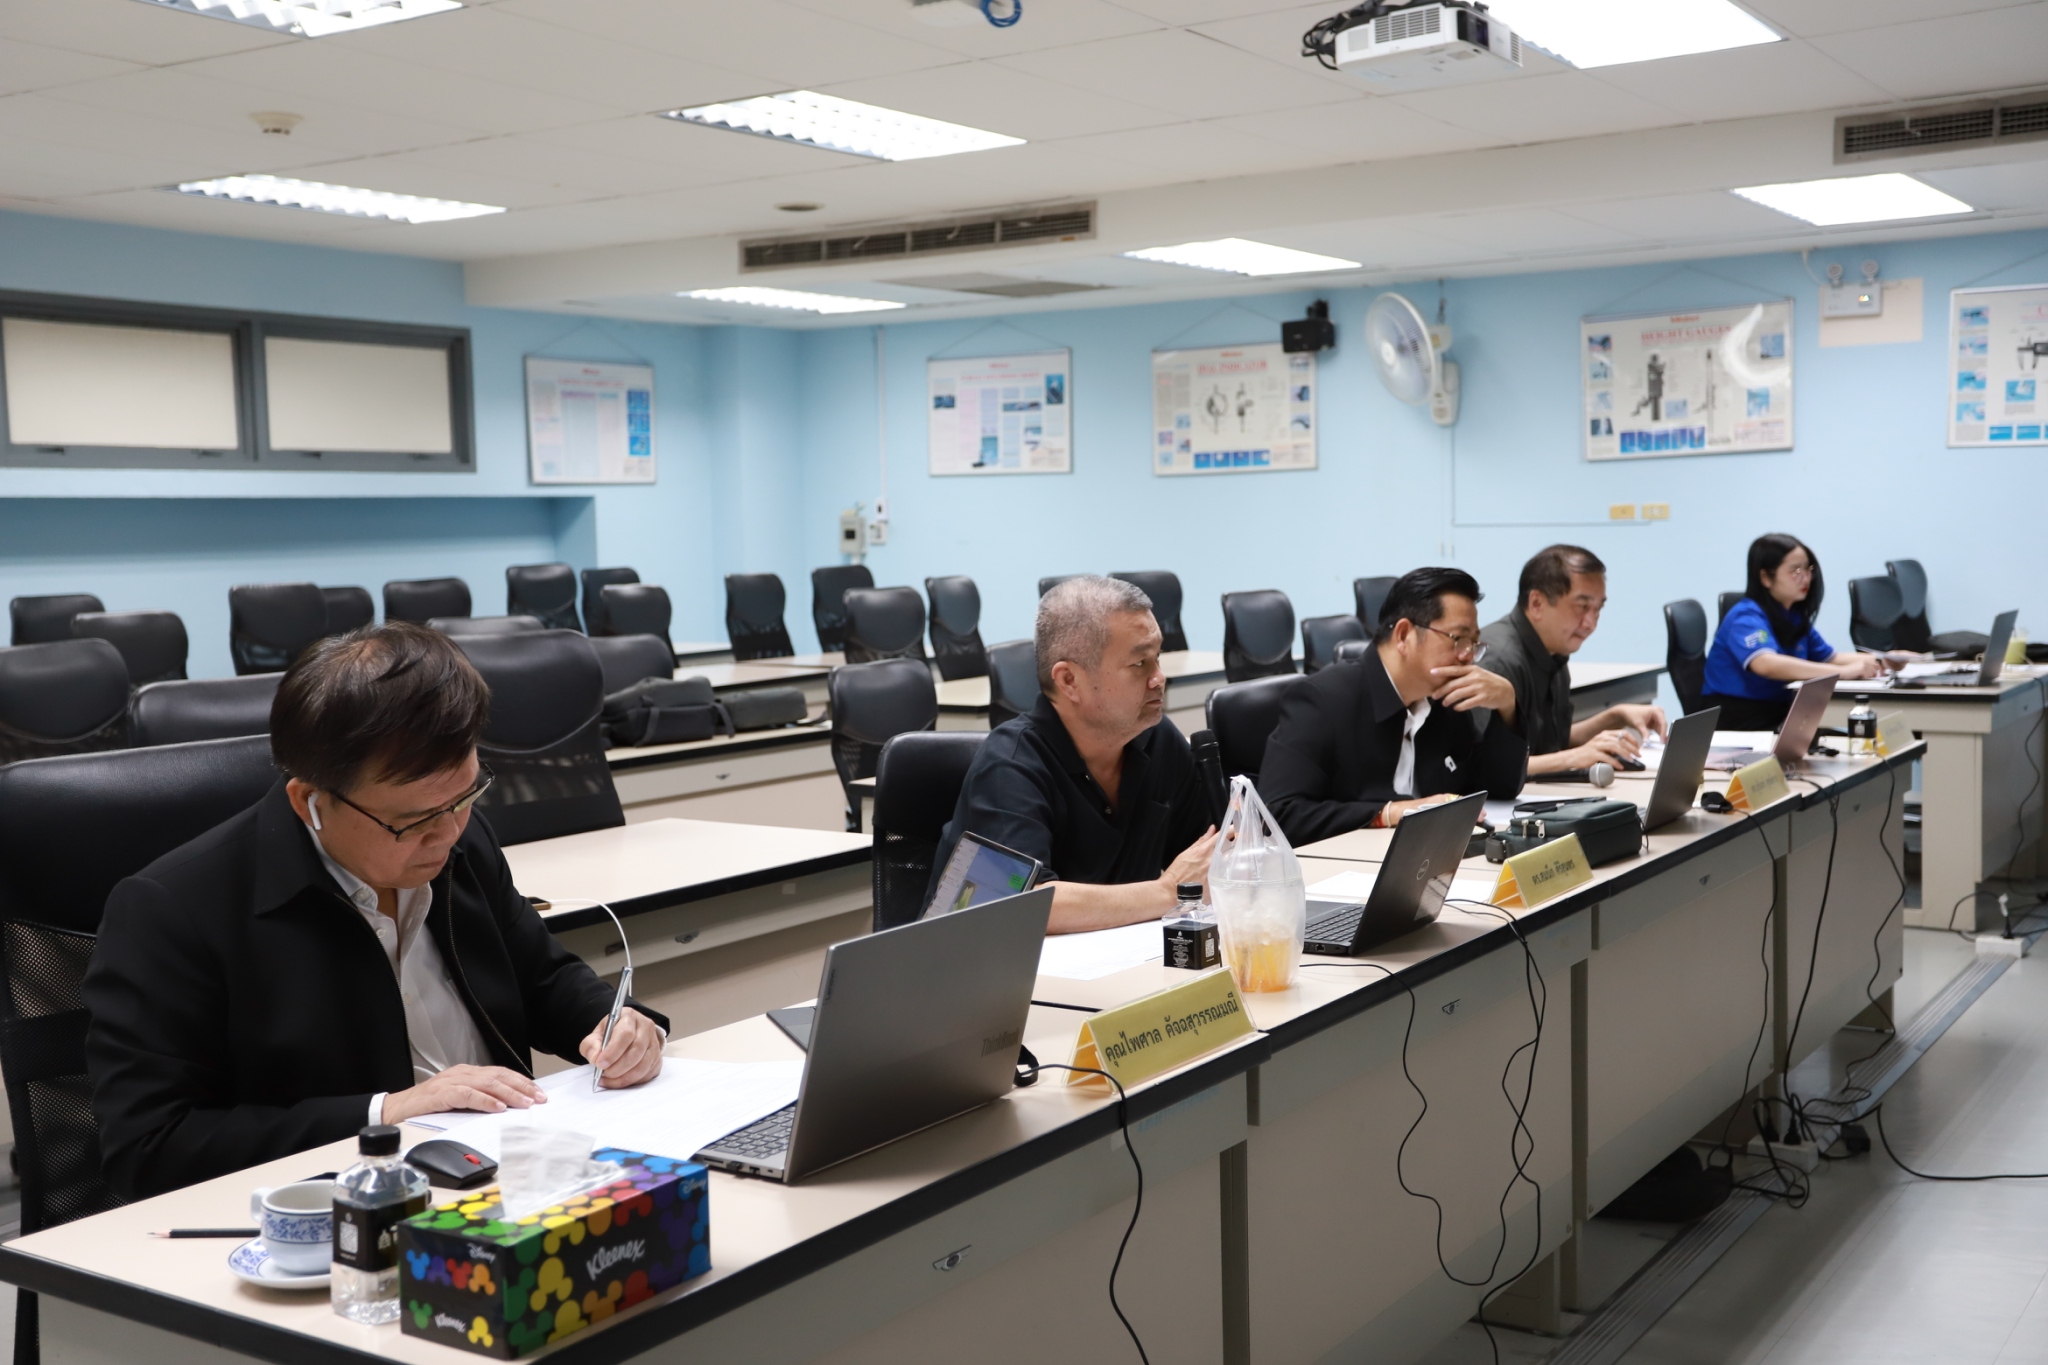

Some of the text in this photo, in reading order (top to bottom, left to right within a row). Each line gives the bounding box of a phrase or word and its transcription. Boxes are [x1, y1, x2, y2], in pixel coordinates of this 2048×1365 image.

[1105, 1031, 1163, 1068] คุณไพศาล
[467, 1243, 496, 1264] Disney
[586, 1239, 646, 1281] Kleenex
[434, 1312, 467, 1334] Kleenex
